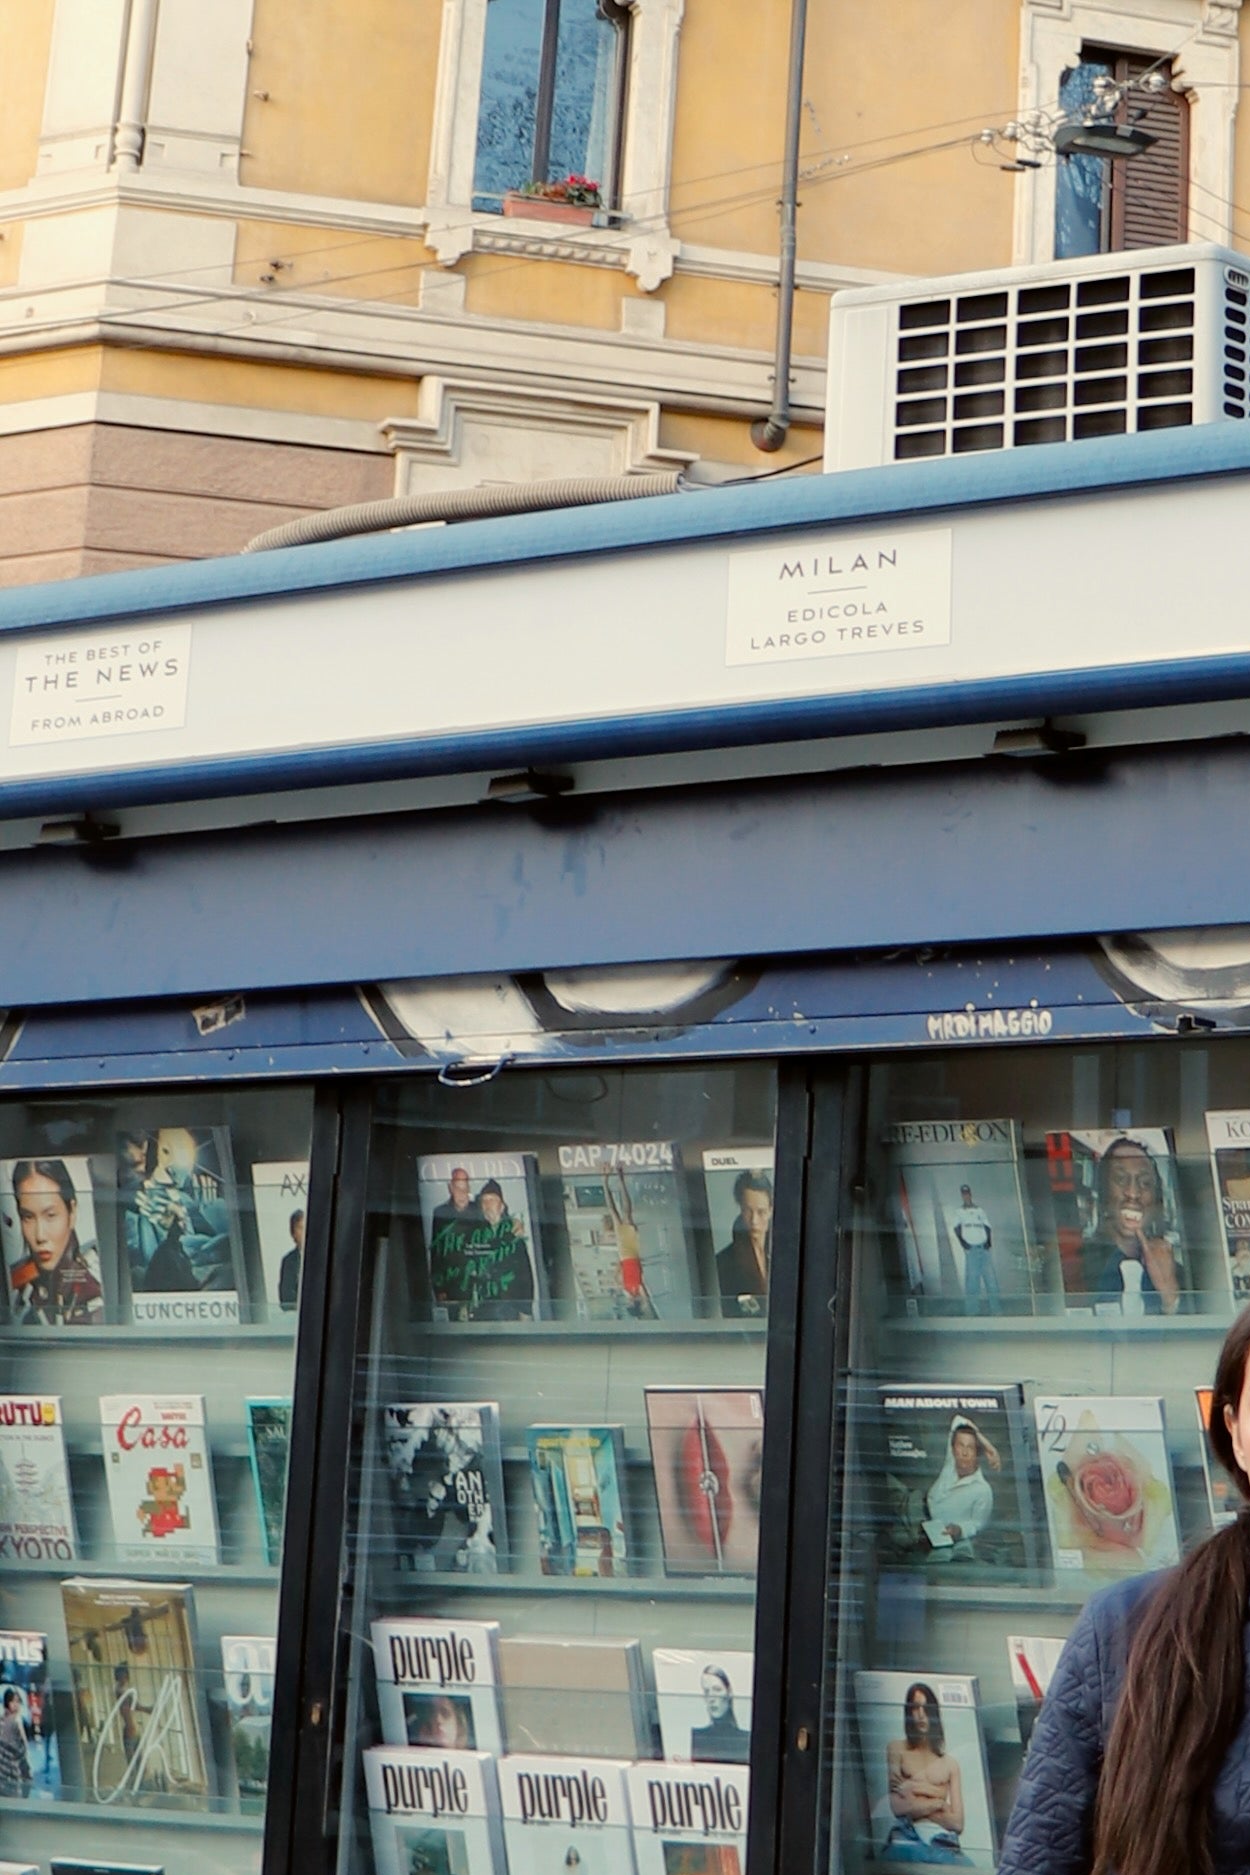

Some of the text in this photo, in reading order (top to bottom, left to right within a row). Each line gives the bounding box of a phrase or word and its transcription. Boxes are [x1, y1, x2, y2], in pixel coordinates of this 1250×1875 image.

[778, 549, 898, 581] MILAN
[787, 601, 888, 623] EDICOLA
[750, 620, 925, 650] LARGO TREVES
[44, 640, 163, 667] THE BEST OF
[24, 659, 179, 693] THE NEWS
[31, 705, 165, 732] FROM ABROAD
[558, 1143, 674, 1169] CAP 74024
[711, 1156, 740, 1167] DUEL
[134, 1300, 239, 1321] LUNCHEON
[116, 1406, 189, 1451] Casa
[455, 1470, 482, 1491] AN
[388, 1631, 476, 1688] purple
[381, 1760, 469, 1818] purple
[517, 1769, 608, 1827] purple
[647, 1776, 742, 1836] purple
